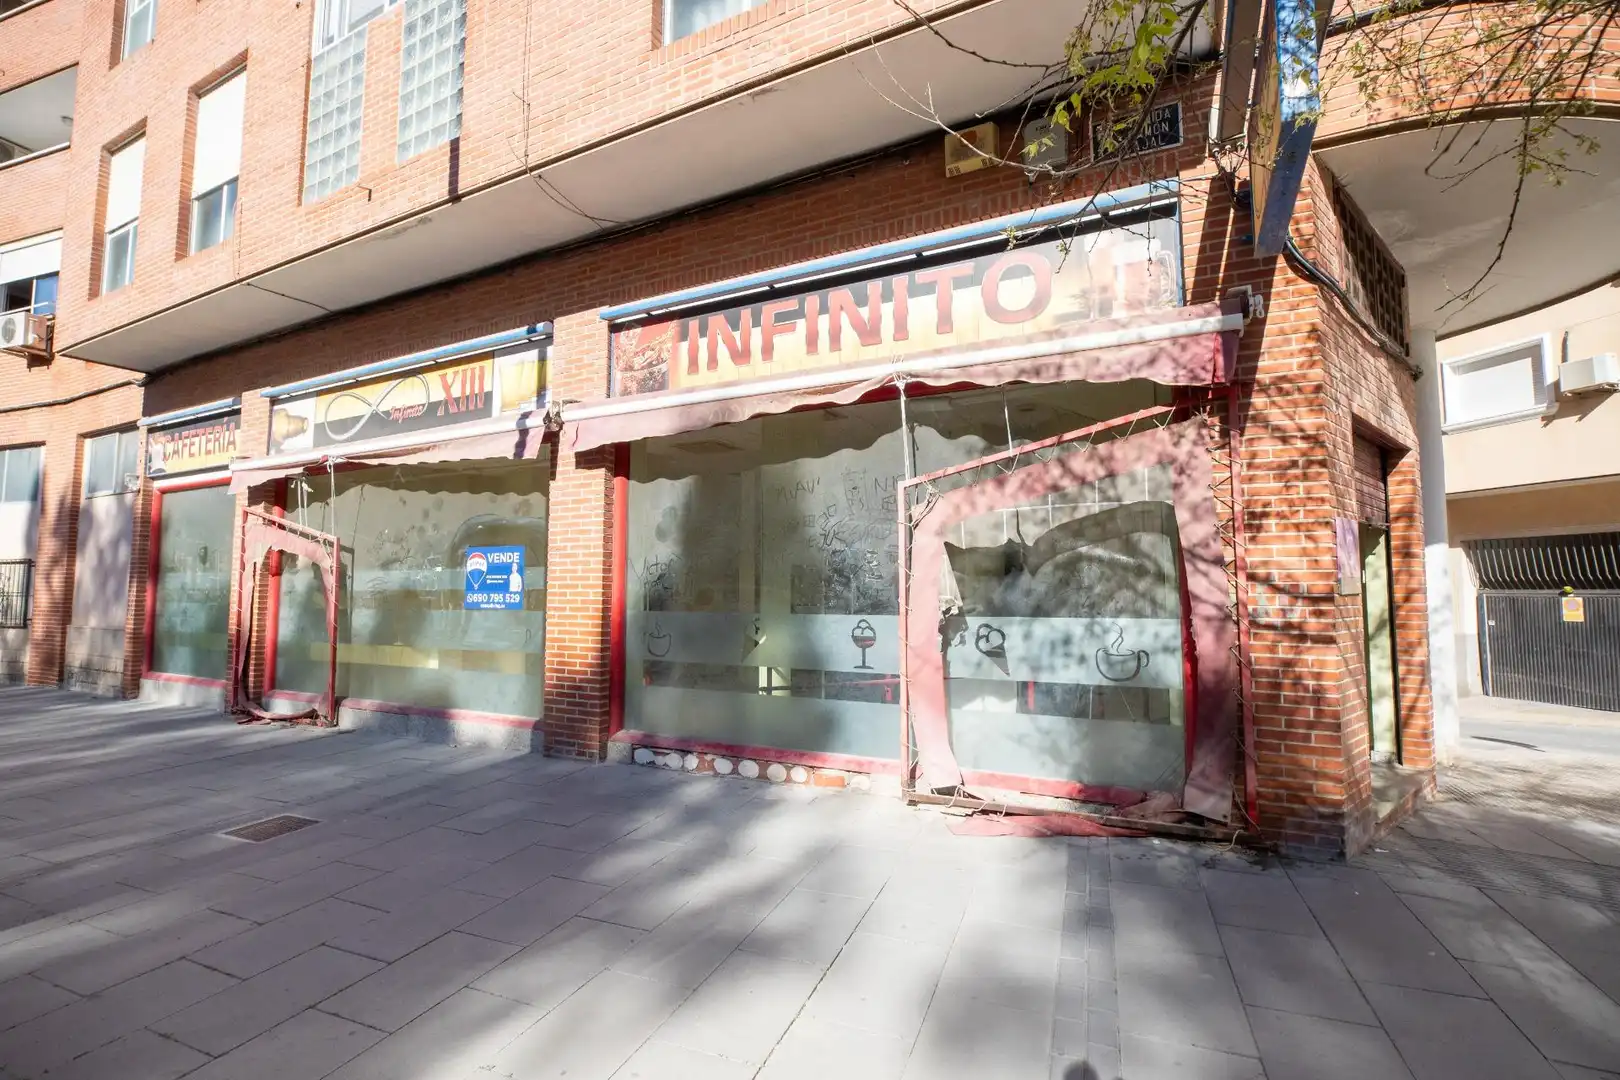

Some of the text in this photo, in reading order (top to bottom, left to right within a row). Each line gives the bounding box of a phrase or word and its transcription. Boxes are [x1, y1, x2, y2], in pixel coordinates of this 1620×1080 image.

[687, 251, 1053, 375] INFINITO
[437, 372, 485, 416] XIII
[162, 416, 237, 462] CAFETERÍA
[487, 551, 520, 563] VENDE
